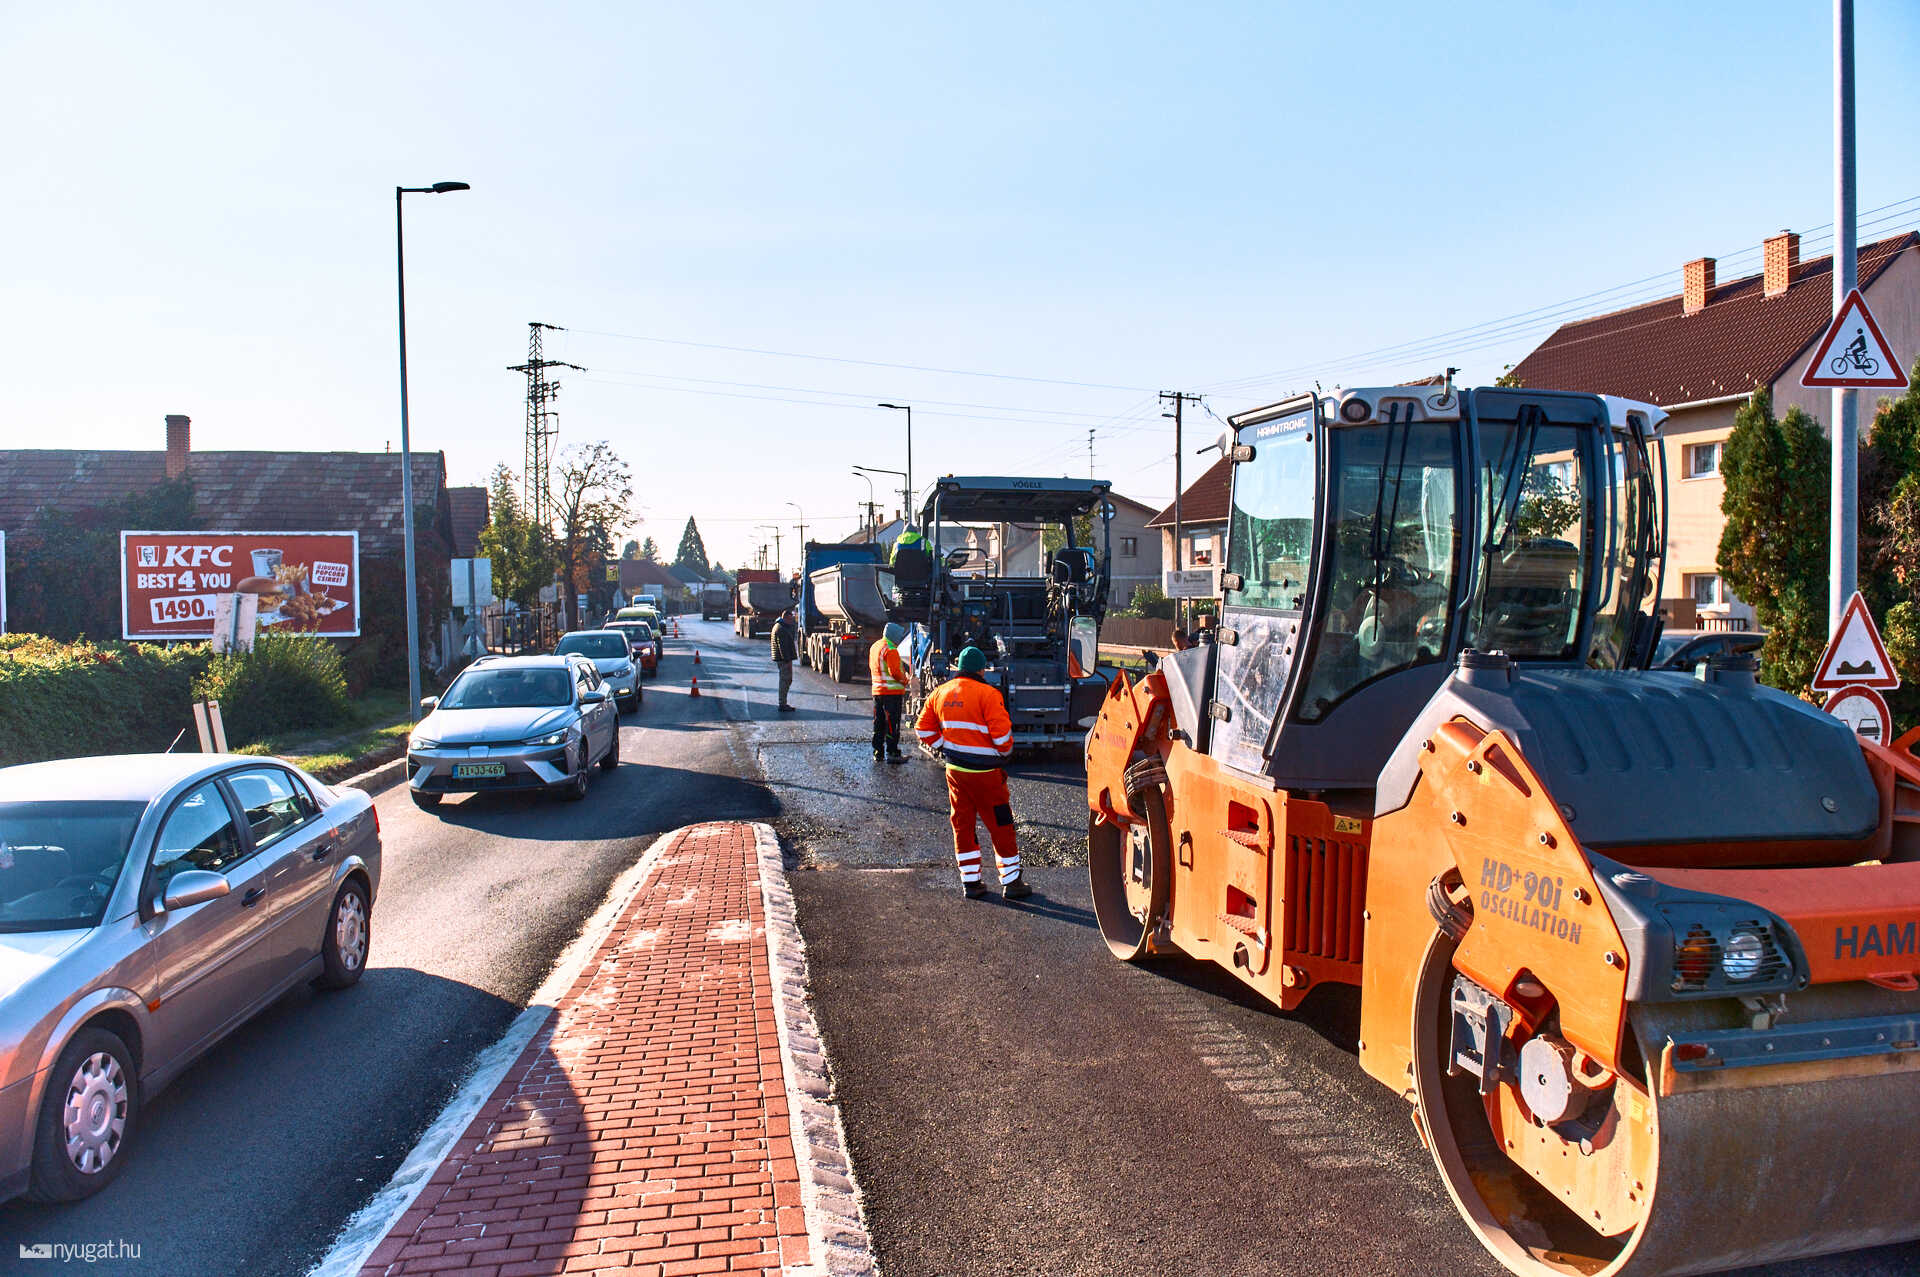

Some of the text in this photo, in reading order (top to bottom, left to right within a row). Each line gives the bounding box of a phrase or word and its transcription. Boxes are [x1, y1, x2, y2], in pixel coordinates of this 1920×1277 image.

[162, 545, 233, 567] KFC
[137, 570, 231, 591] BEST 4 YOU
[315, 569, 346, 577] POPCORN
[154, 598, 205, 621] 1490
[1480, 890, 1582, 945] OSCILLATION
[1834, 921, 1920, 960] HAM
